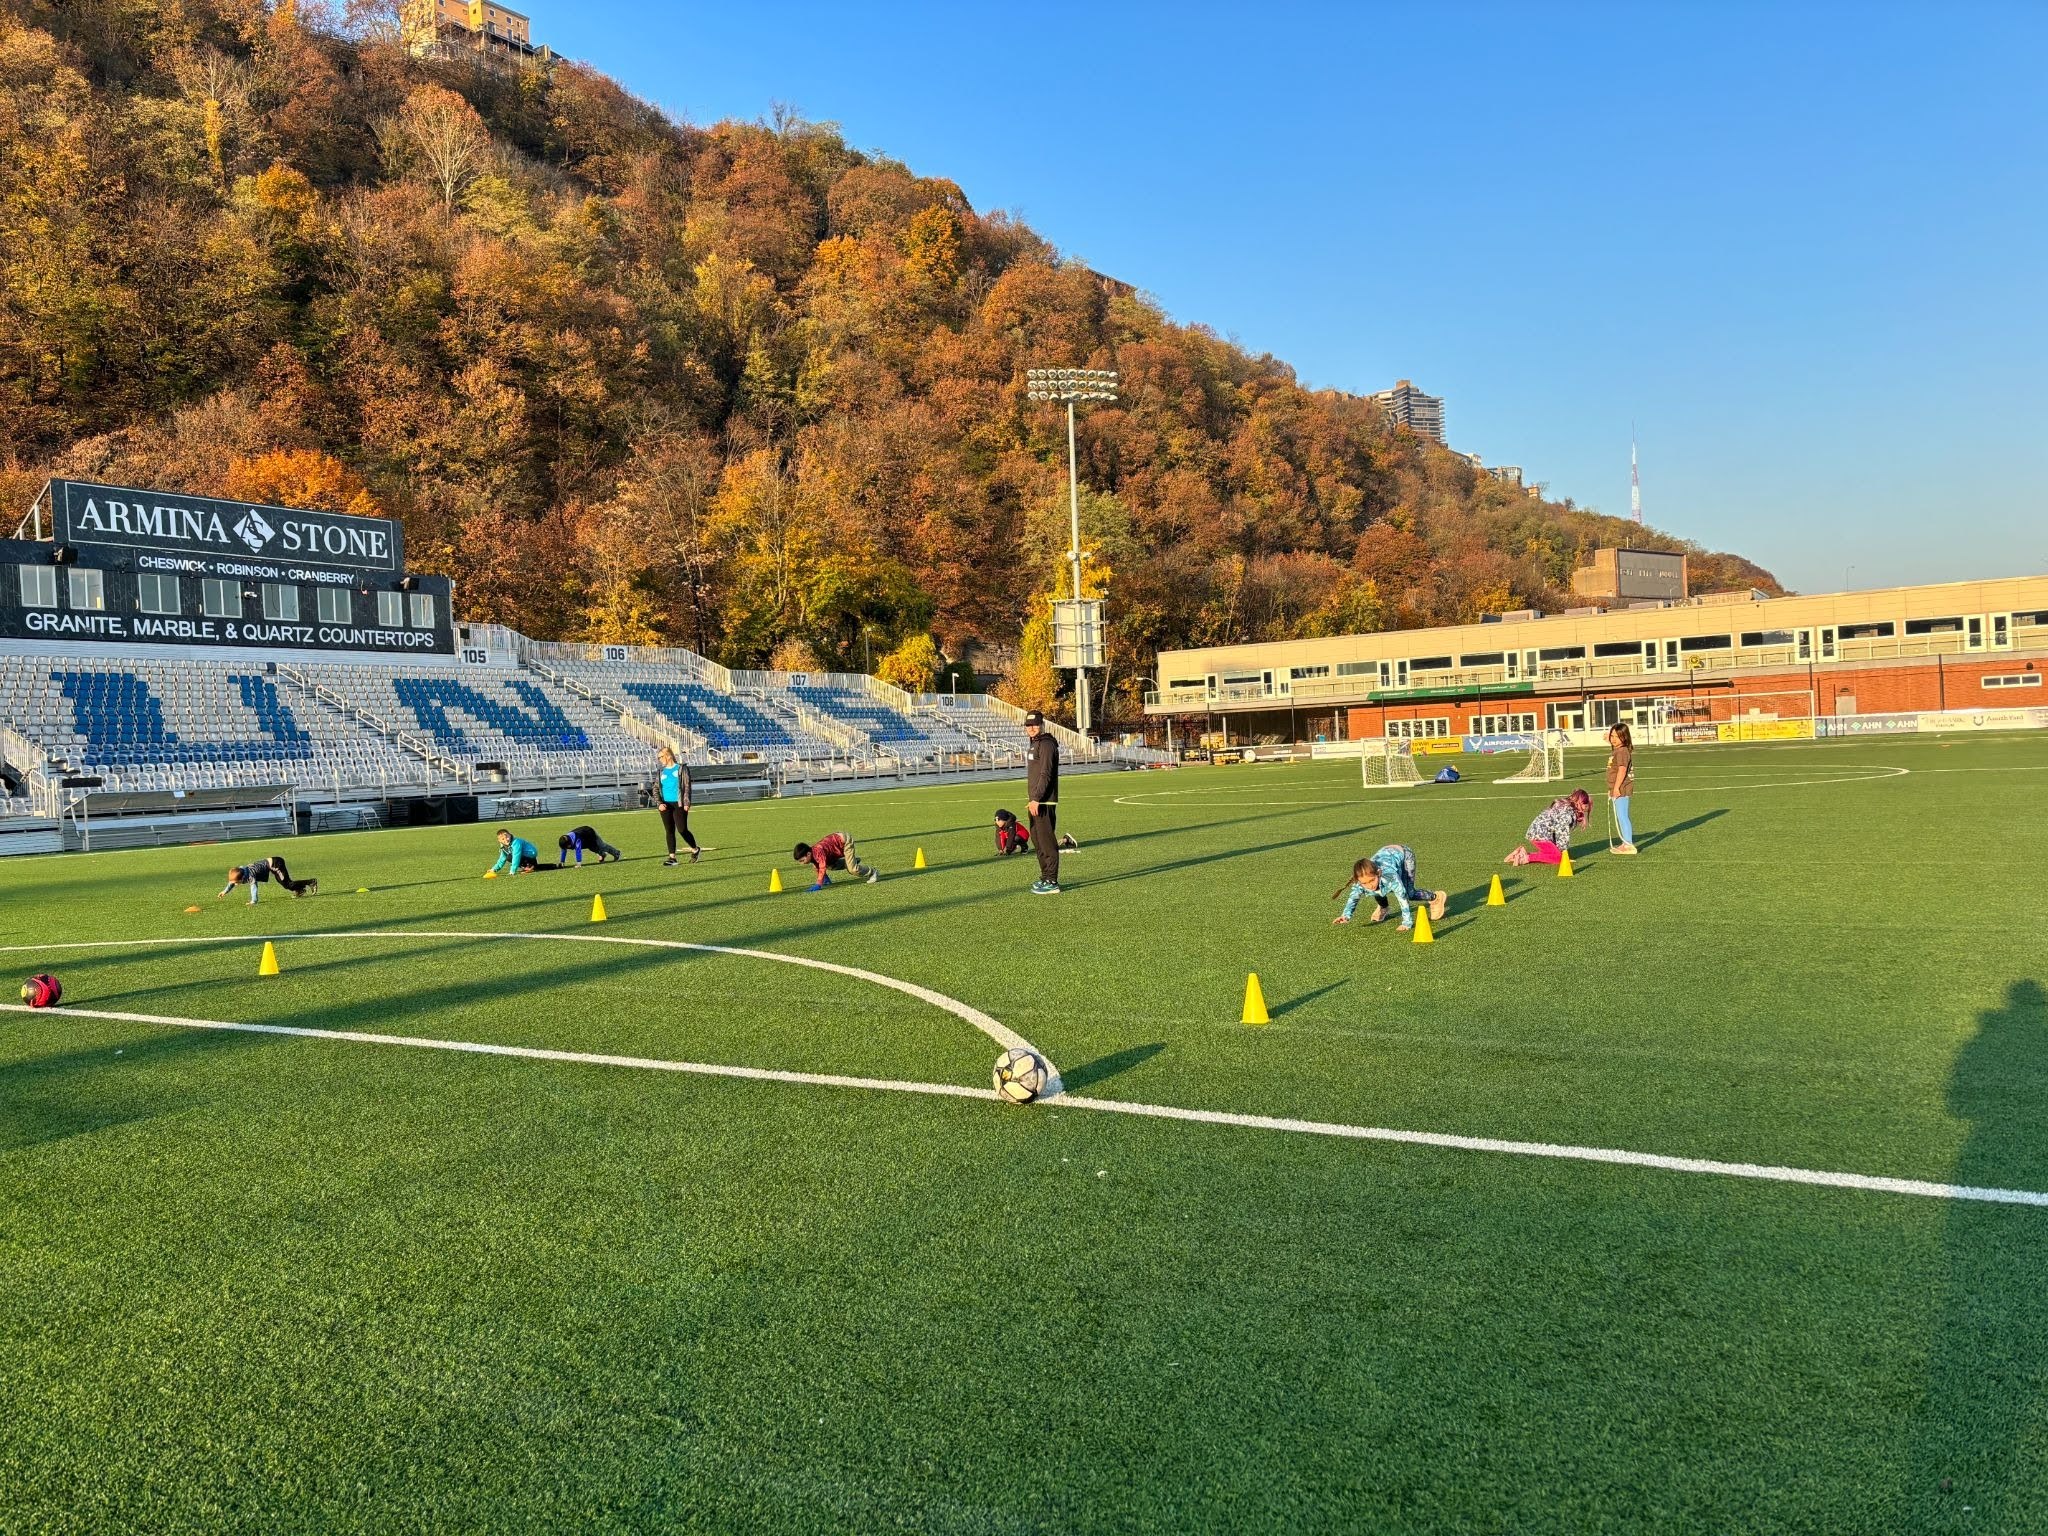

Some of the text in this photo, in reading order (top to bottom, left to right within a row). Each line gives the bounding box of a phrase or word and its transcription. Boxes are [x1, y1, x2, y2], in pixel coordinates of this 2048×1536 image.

[77, 498, 388, 559] ARMINA STONE
[139, 556, 355, 585] CHESWICK ROBINSON CRANBERRY
[26, 612, 434, 647] GRANITE, MARBLE, & QUARTZ COUNTERTOPS
[463, 649, 486, 664] 105
[606, 647, 625, 660] 106
[792, 674, 807, 686] 107
[941, 696, 954, 707] 108
[1827, 723, 1847, 731] AHN
[1862, 721, 1882, 729] AHN
[1897, 720, 1918, 728] AHN
